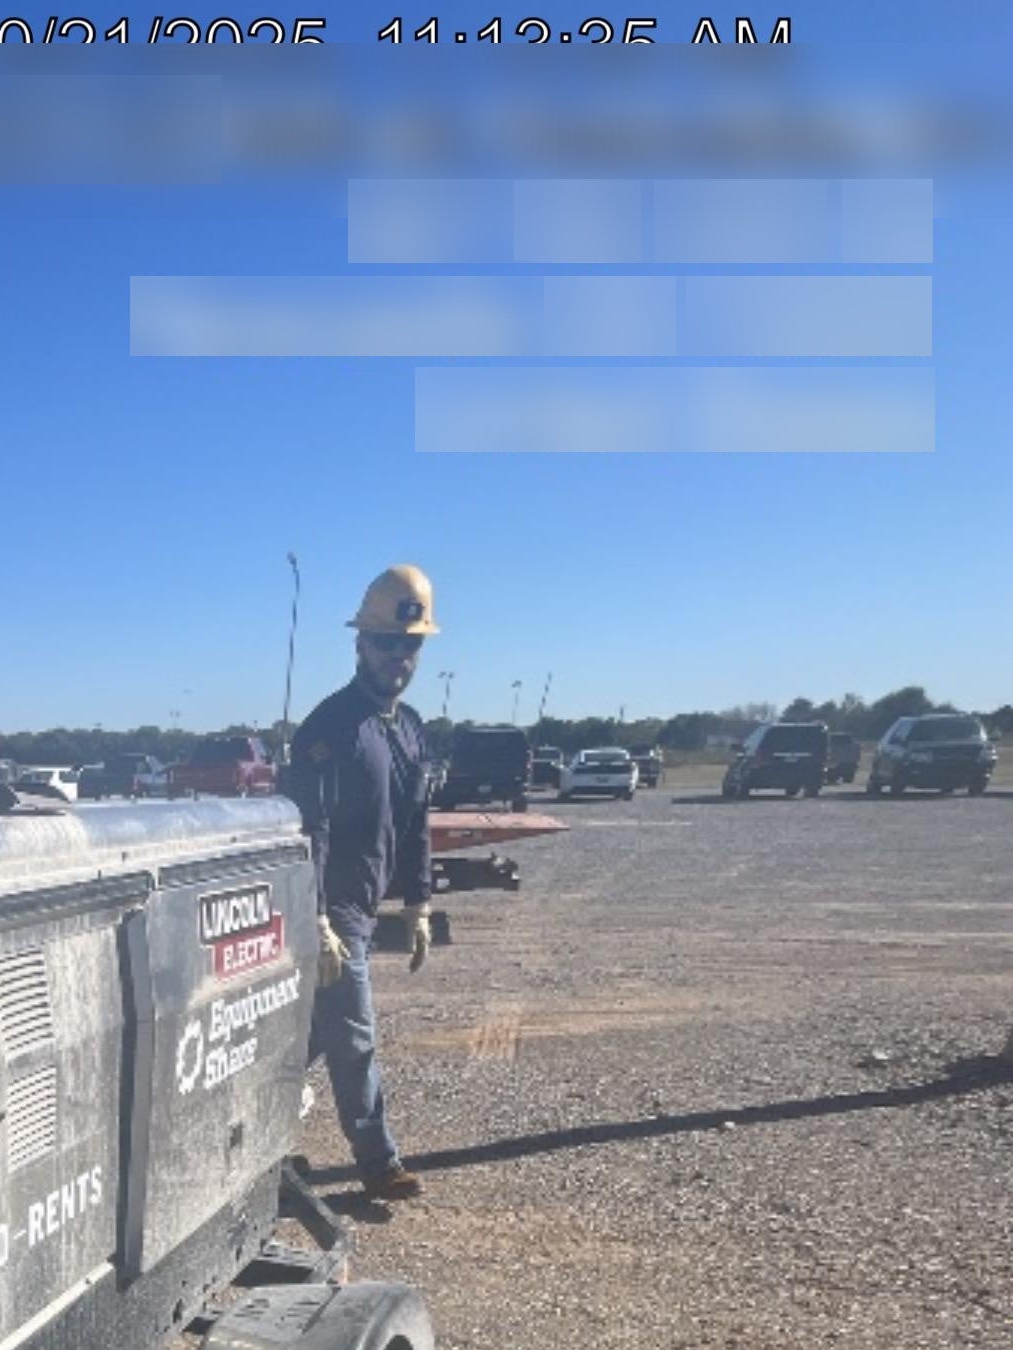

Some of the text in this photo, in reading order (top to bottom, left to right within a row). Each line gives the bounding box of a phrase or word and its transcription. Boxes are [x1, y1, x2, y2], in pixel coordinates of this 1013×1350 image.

[201, 890, 271, 939] LINCOLN
[208, 967, 302, 1042] Equipment
[203, 1037, 258, 1090] Share
